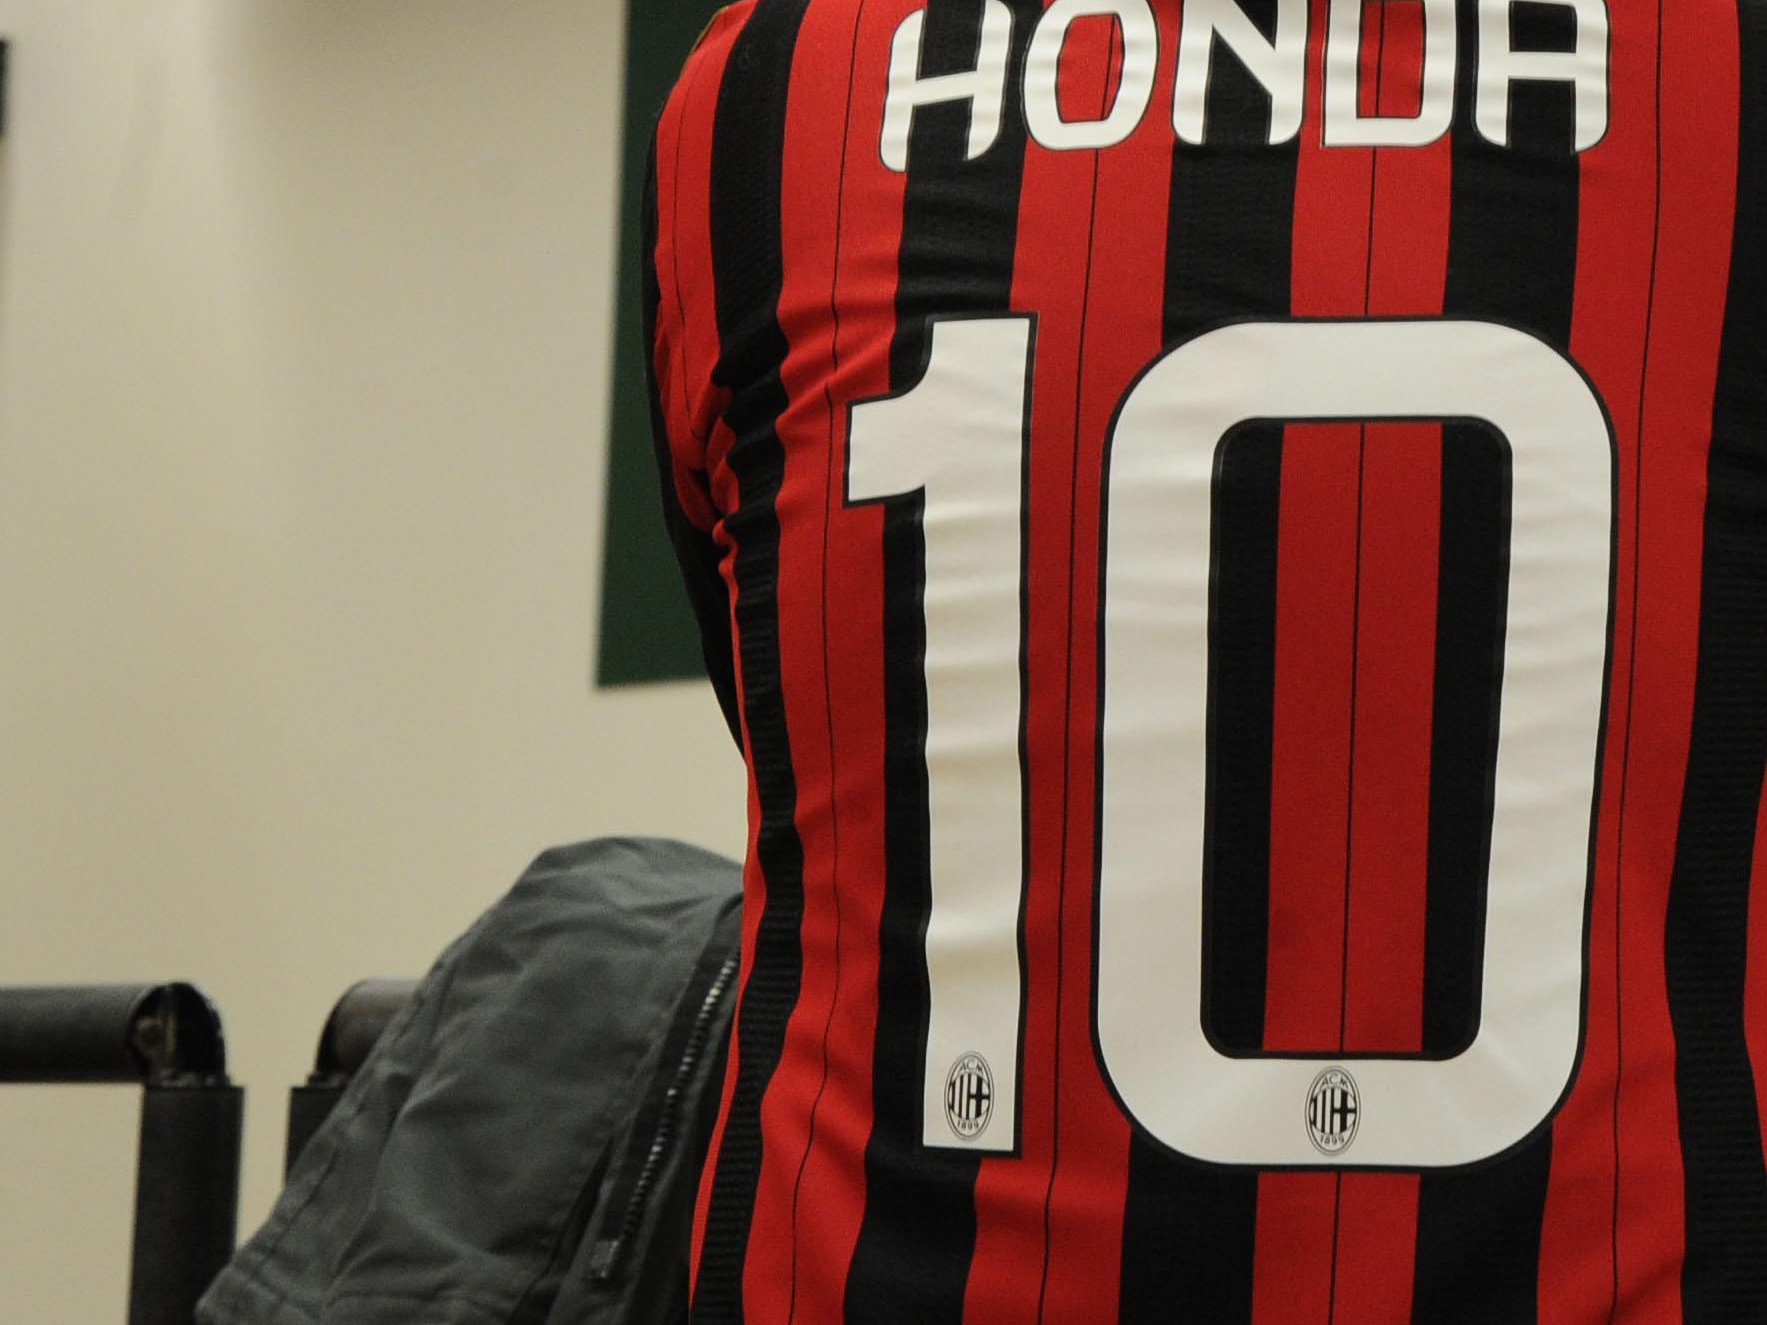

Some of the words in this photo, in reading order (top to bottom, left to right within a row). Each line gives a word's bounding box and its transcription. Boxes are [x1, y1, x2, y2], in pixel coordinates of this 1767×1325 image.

[845, 317, 1615, 1168] 10
[1321, 1073, 1349, 1088] ACM
[956, 1119, 980, 1132] 1899
[1319, 1133, 1346, 1147] 1899
